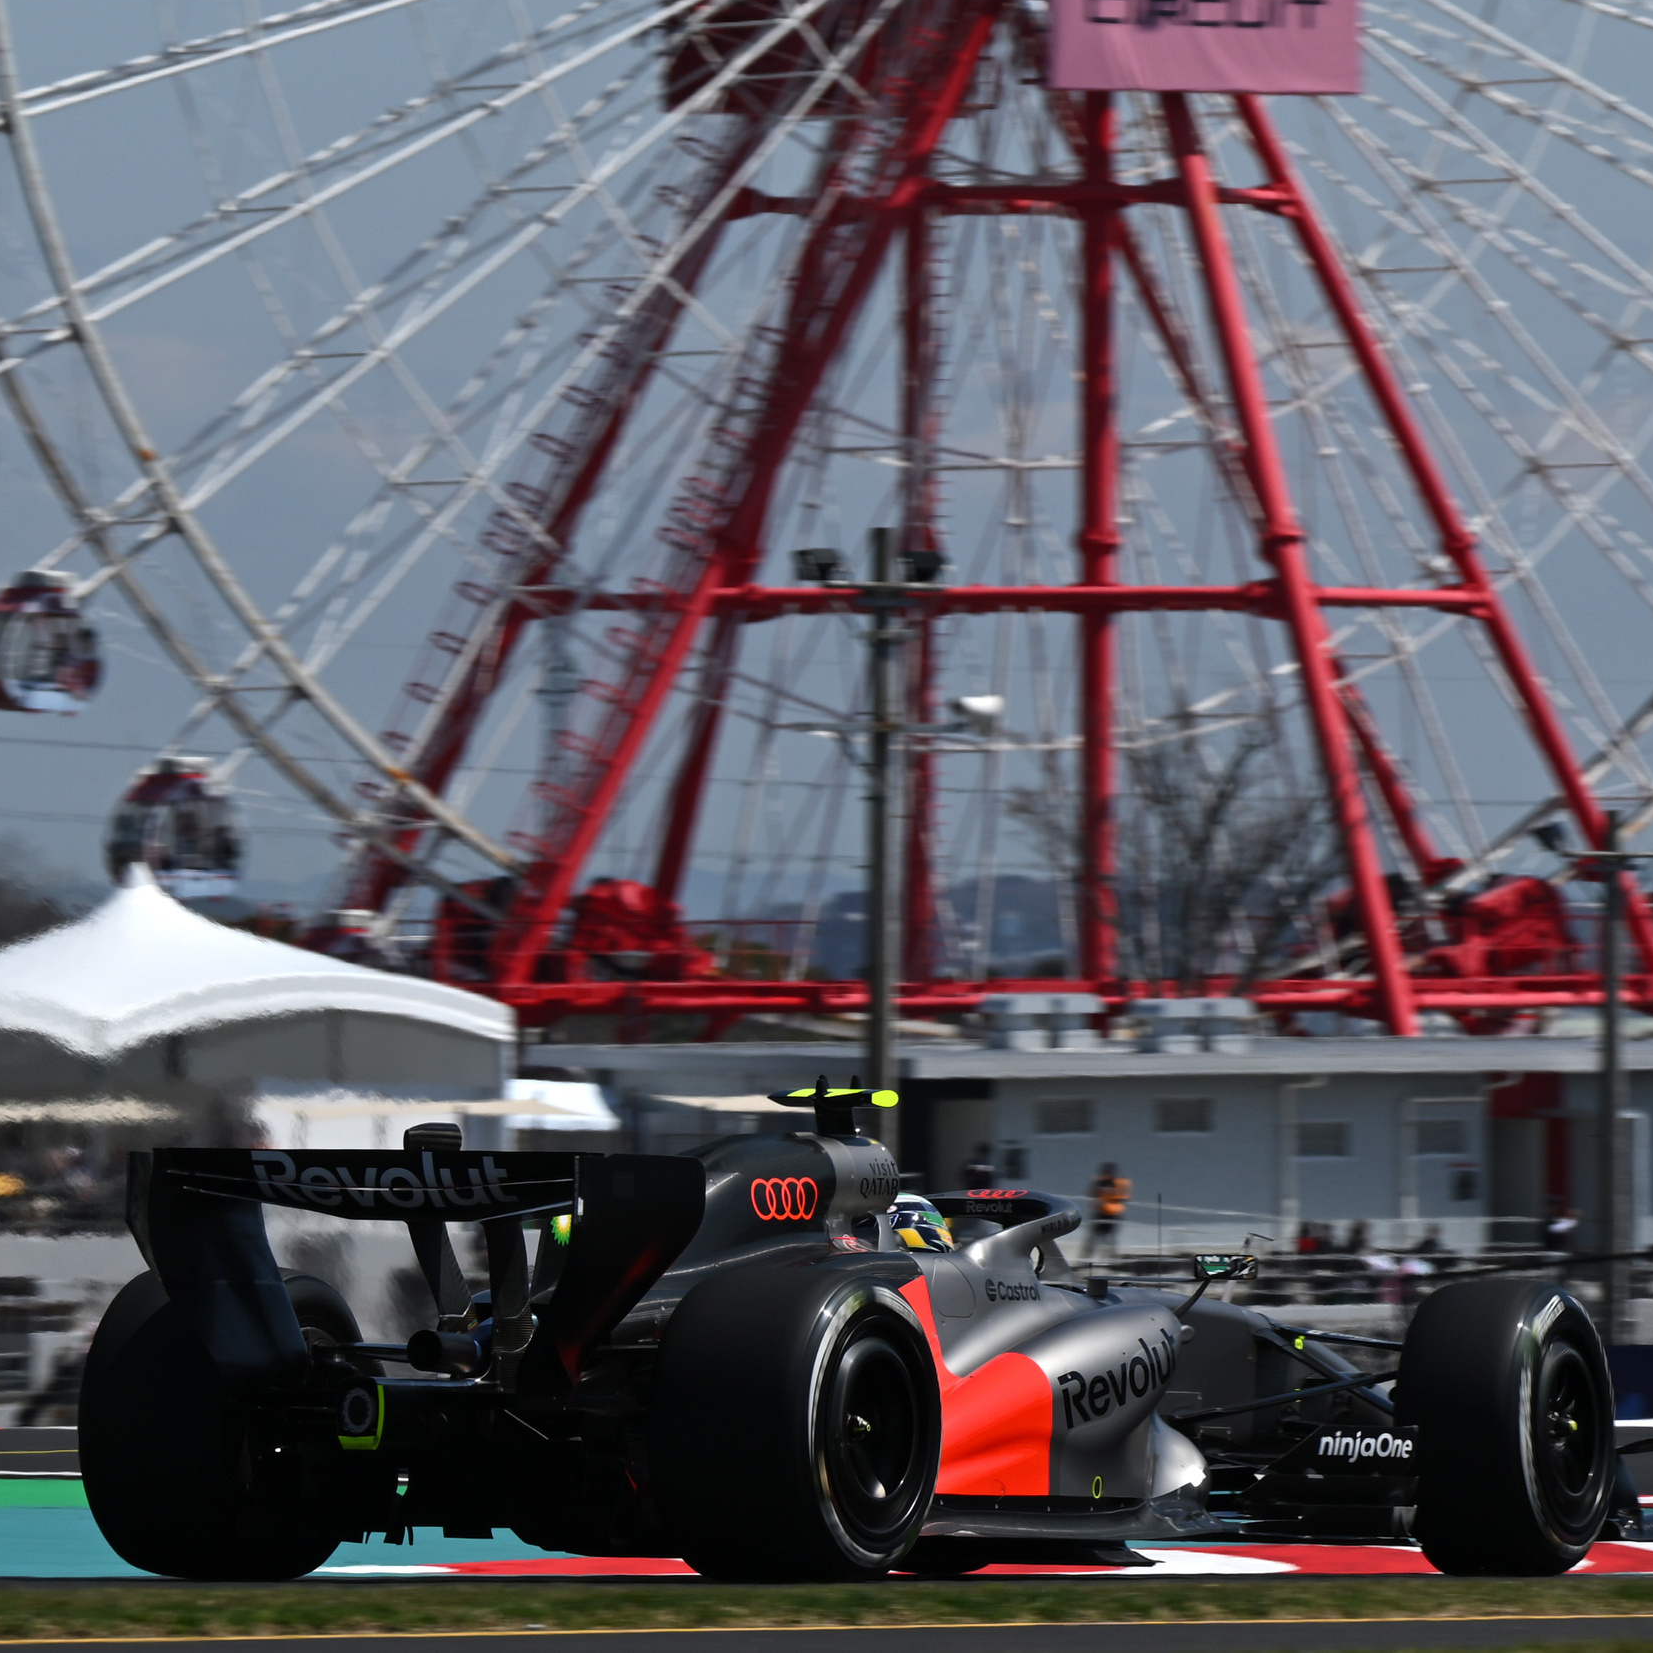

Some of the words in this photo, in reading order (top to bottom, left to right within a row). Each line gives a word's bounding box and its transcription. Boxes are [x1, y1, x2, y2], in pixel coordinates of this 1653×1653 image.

[869, 1157, 898, 1177] visit
[250, 1150, 519, 1208] Revolut
[860, 1177, 899, 1199] QATAR
[966, 1200, 1013, 1214] Revolut
[997, 1280, 1041, 1302] Castrol
[1057, 1327, 1176, 1430] Revolut
[1318, 1430, 1413, 1463] ninjaOne
